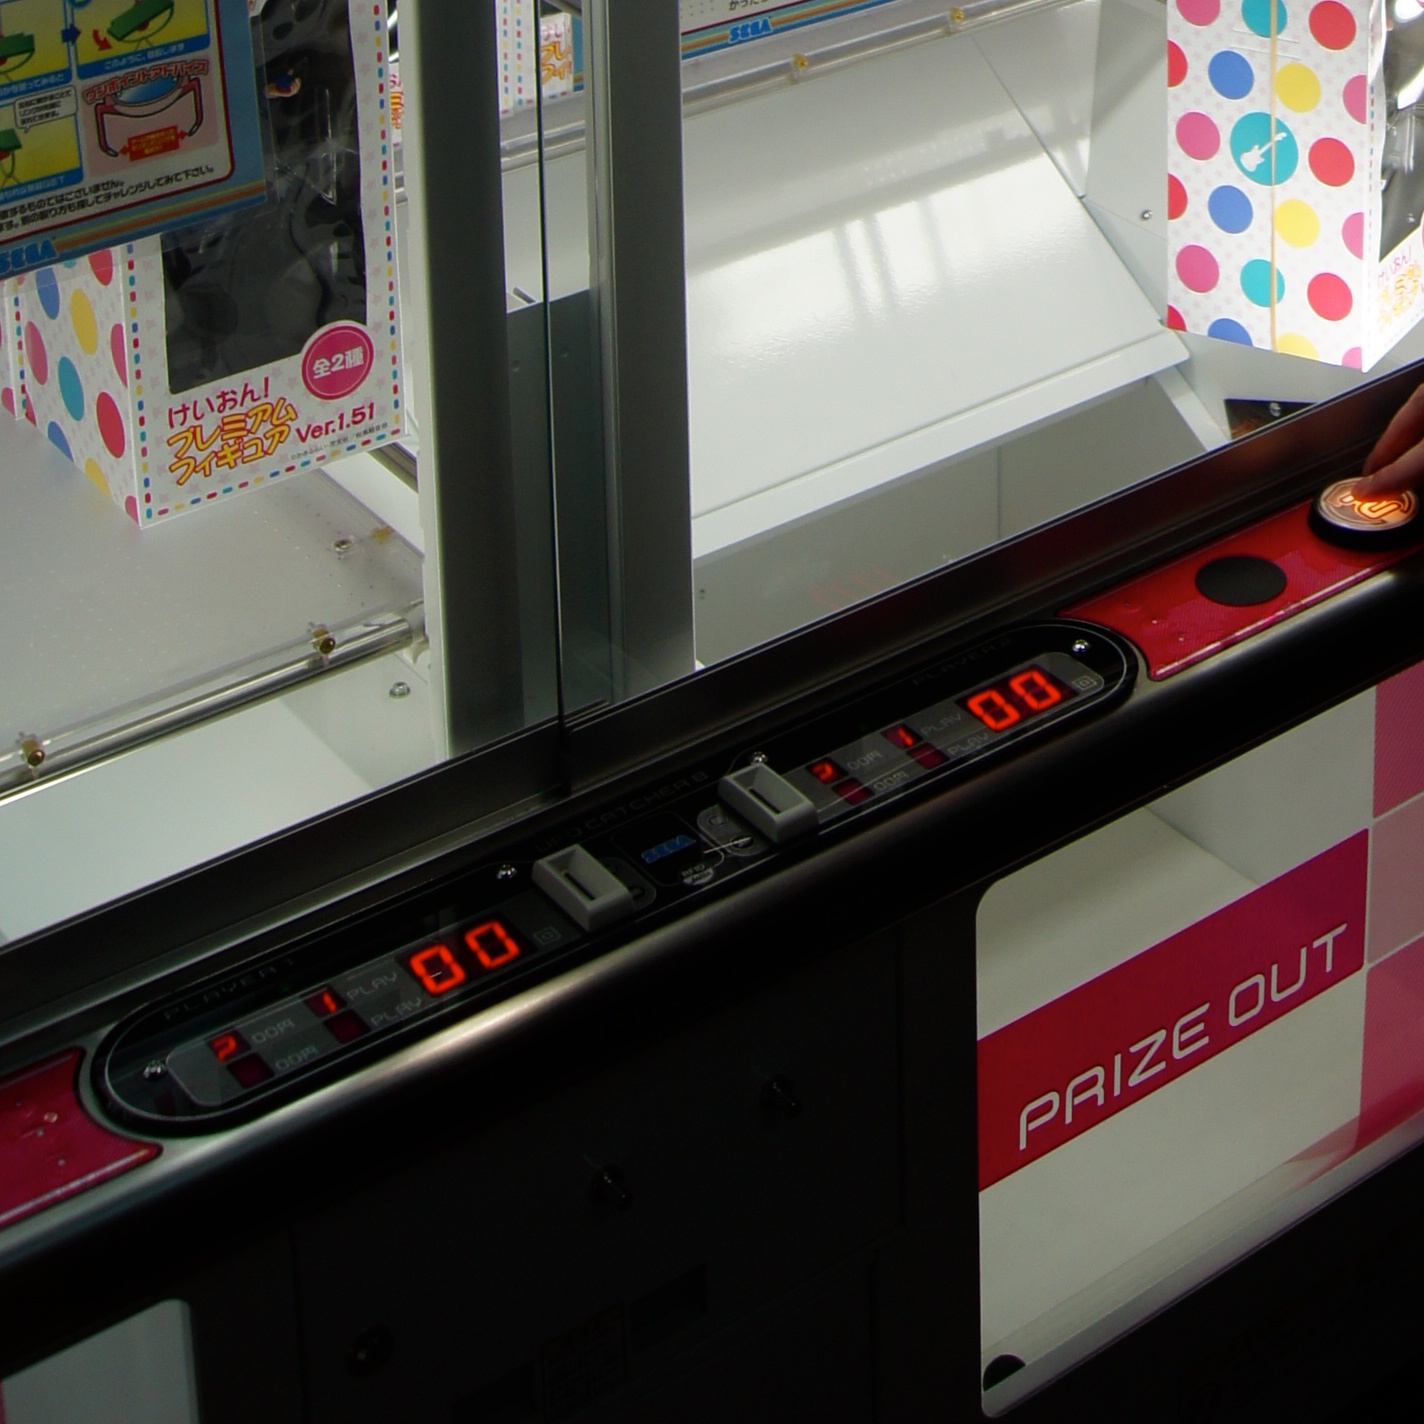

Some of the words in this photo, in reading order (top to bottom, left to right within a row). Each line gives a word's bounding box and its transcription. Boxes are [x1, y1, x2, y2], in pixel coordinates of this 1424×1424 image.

[729, 17, 772, 43] SEGA
[166, 397, 298, 457] プレミアム
[167, 375, 271, 430] けいおん!
[295, 402, 375, 445] Ver.1.51
[168, 422, 291, 487] フィギュア
[965, 666, 1064, 733] 00
[584, 779, 690, 830] CATCHER
[408, 918, 524, 998] 00
[1018, 1002, 1211, 1152] PRIZE
[1228, 922, 1348, 1028] OUT
